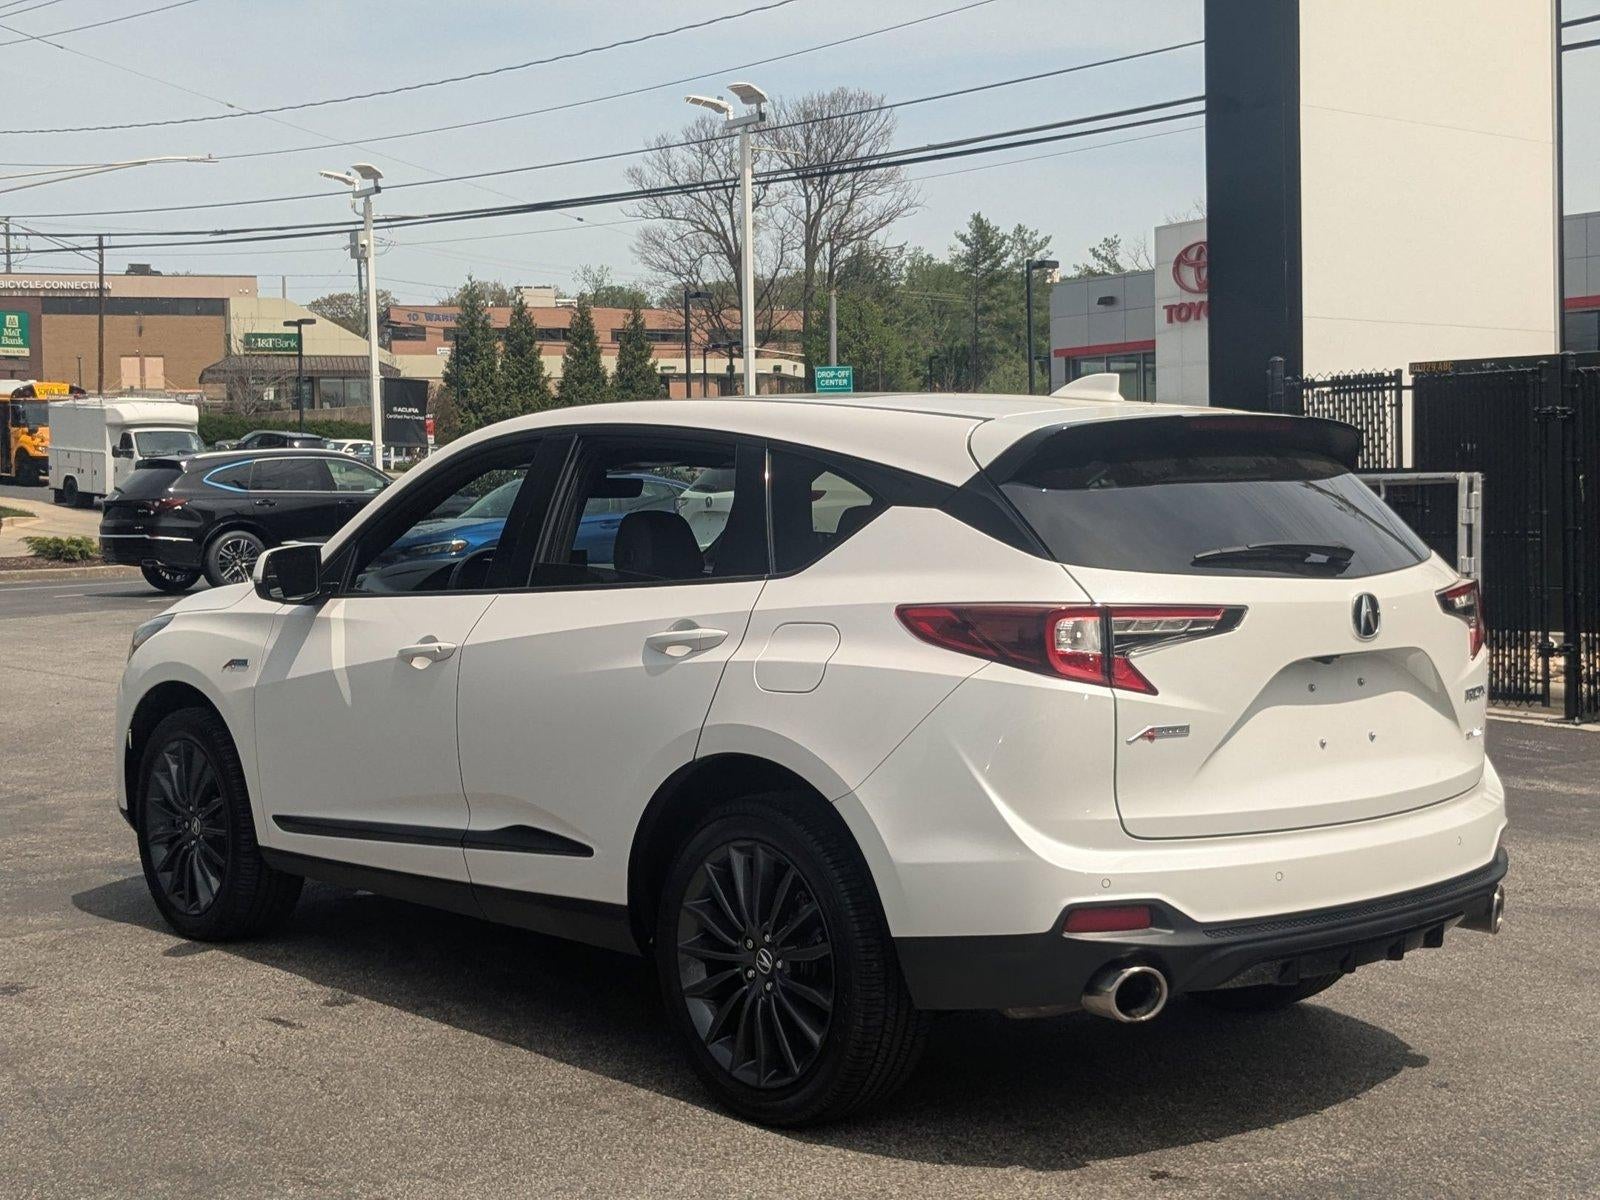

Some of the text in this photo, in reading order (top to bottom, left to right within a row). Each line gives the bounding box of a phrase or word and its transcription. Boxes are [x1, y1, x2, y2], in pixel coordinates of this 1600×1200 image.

[44, 281, 112, 290] CONNECTIN
[3, 328, 21, 336] M&T
[1, 336, 24, 345] Bank
[275, 338, 298, 348] Bank
